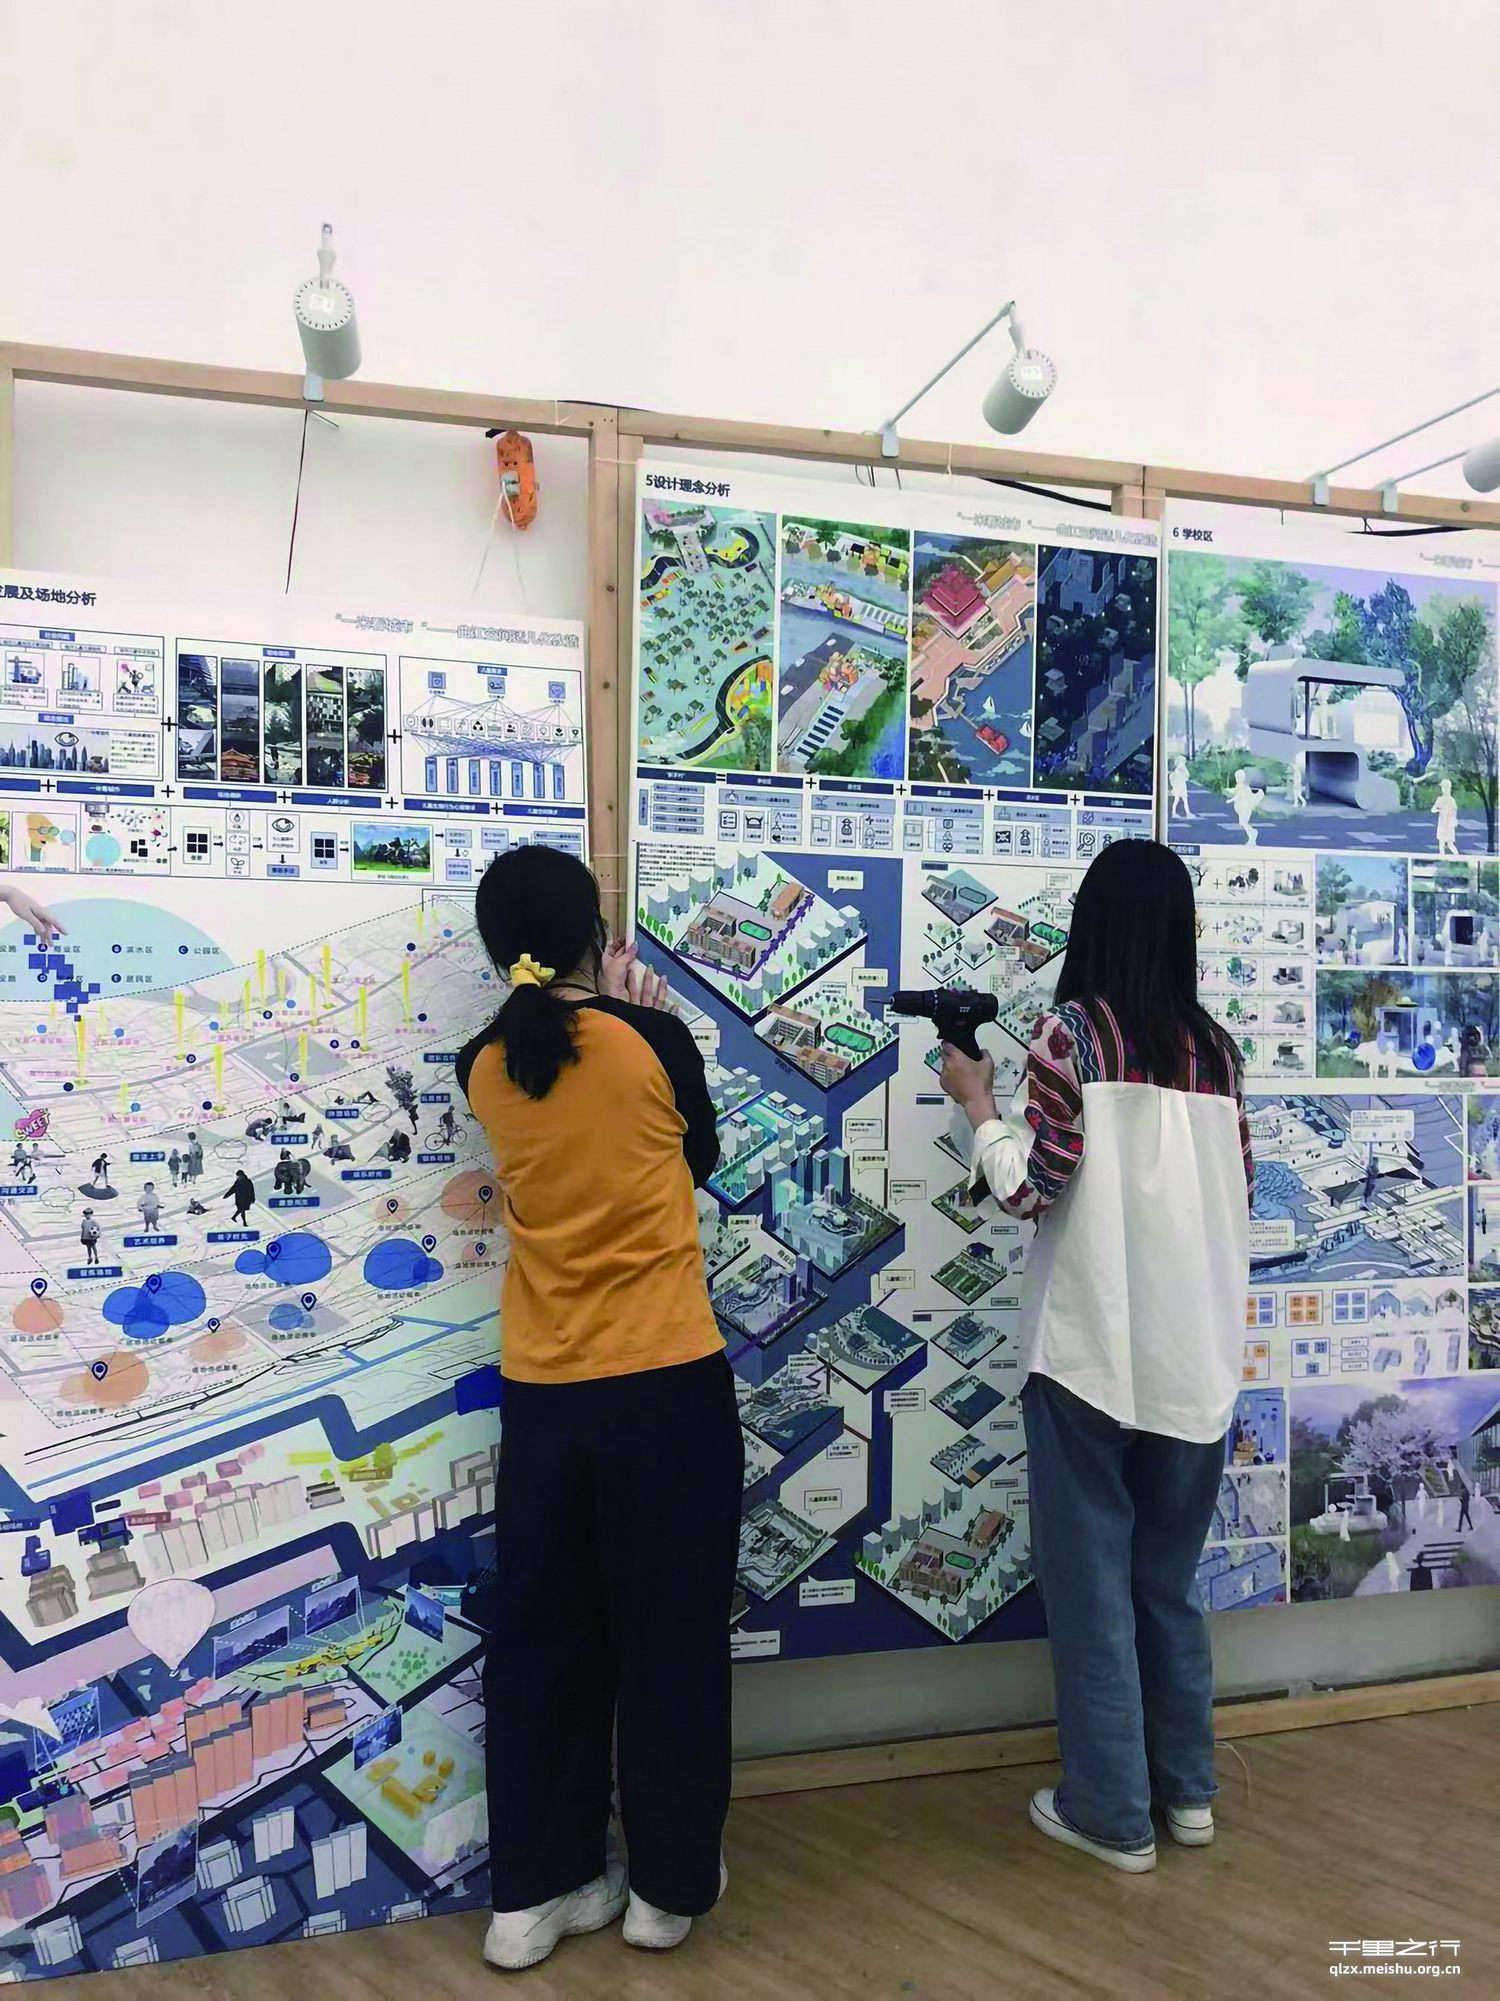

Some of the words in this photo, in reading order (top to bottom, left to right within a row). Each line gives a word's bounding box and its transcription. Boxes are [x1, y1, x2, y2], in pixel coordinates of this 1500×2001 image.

[646, 474, 730, 498] 5设计理念分析
[1173, 528, 1179, 538] 6
[1182, 528, 1213, 542] 学校区
[0, 585, 97, 606] 展及场地分析
[14, 1109, 51, 1140] SWEET
